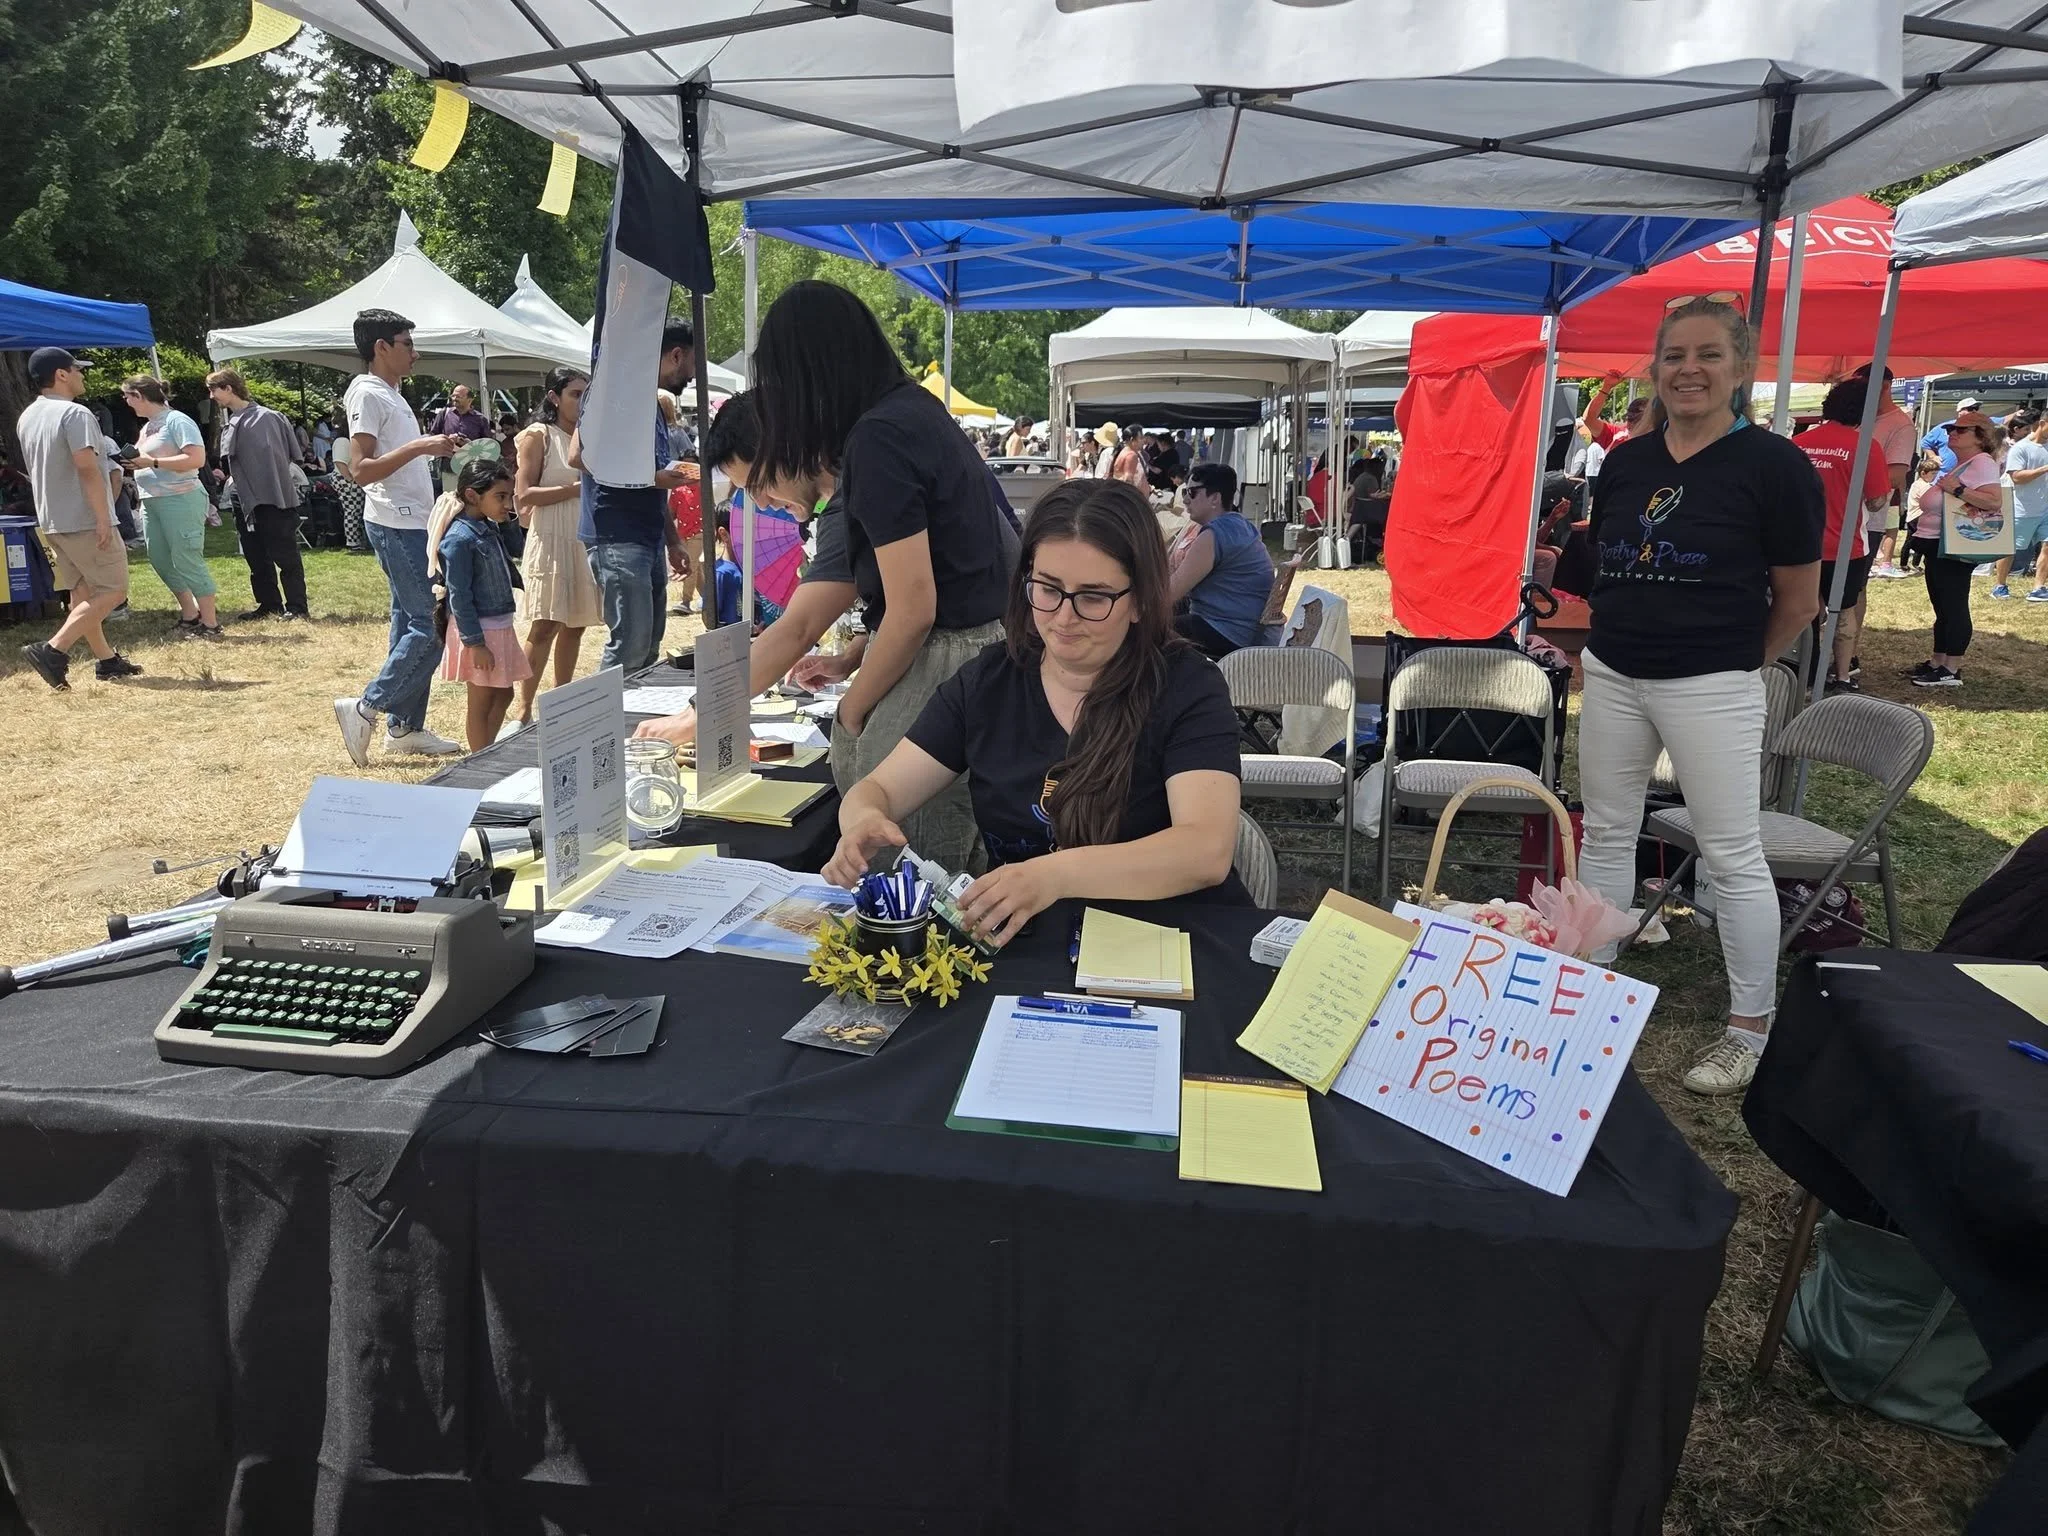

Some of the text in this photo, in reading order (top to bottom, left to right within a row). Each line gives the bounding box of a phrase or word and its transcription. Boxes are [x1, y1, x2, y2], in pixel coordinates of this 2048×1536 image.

[1798, 446, 1849, 460] ommunity
[1654, 541, 1707, 568] Prose
[1609, 571, 1676, 581] NETWORK
[1408, 922, 1586, 1016] FREE
[1063, 1004, 1089, 1014] VAL
[1410, 984, 1567, 1077] Original
[1408, 1037, 1537, 1120] Poems
